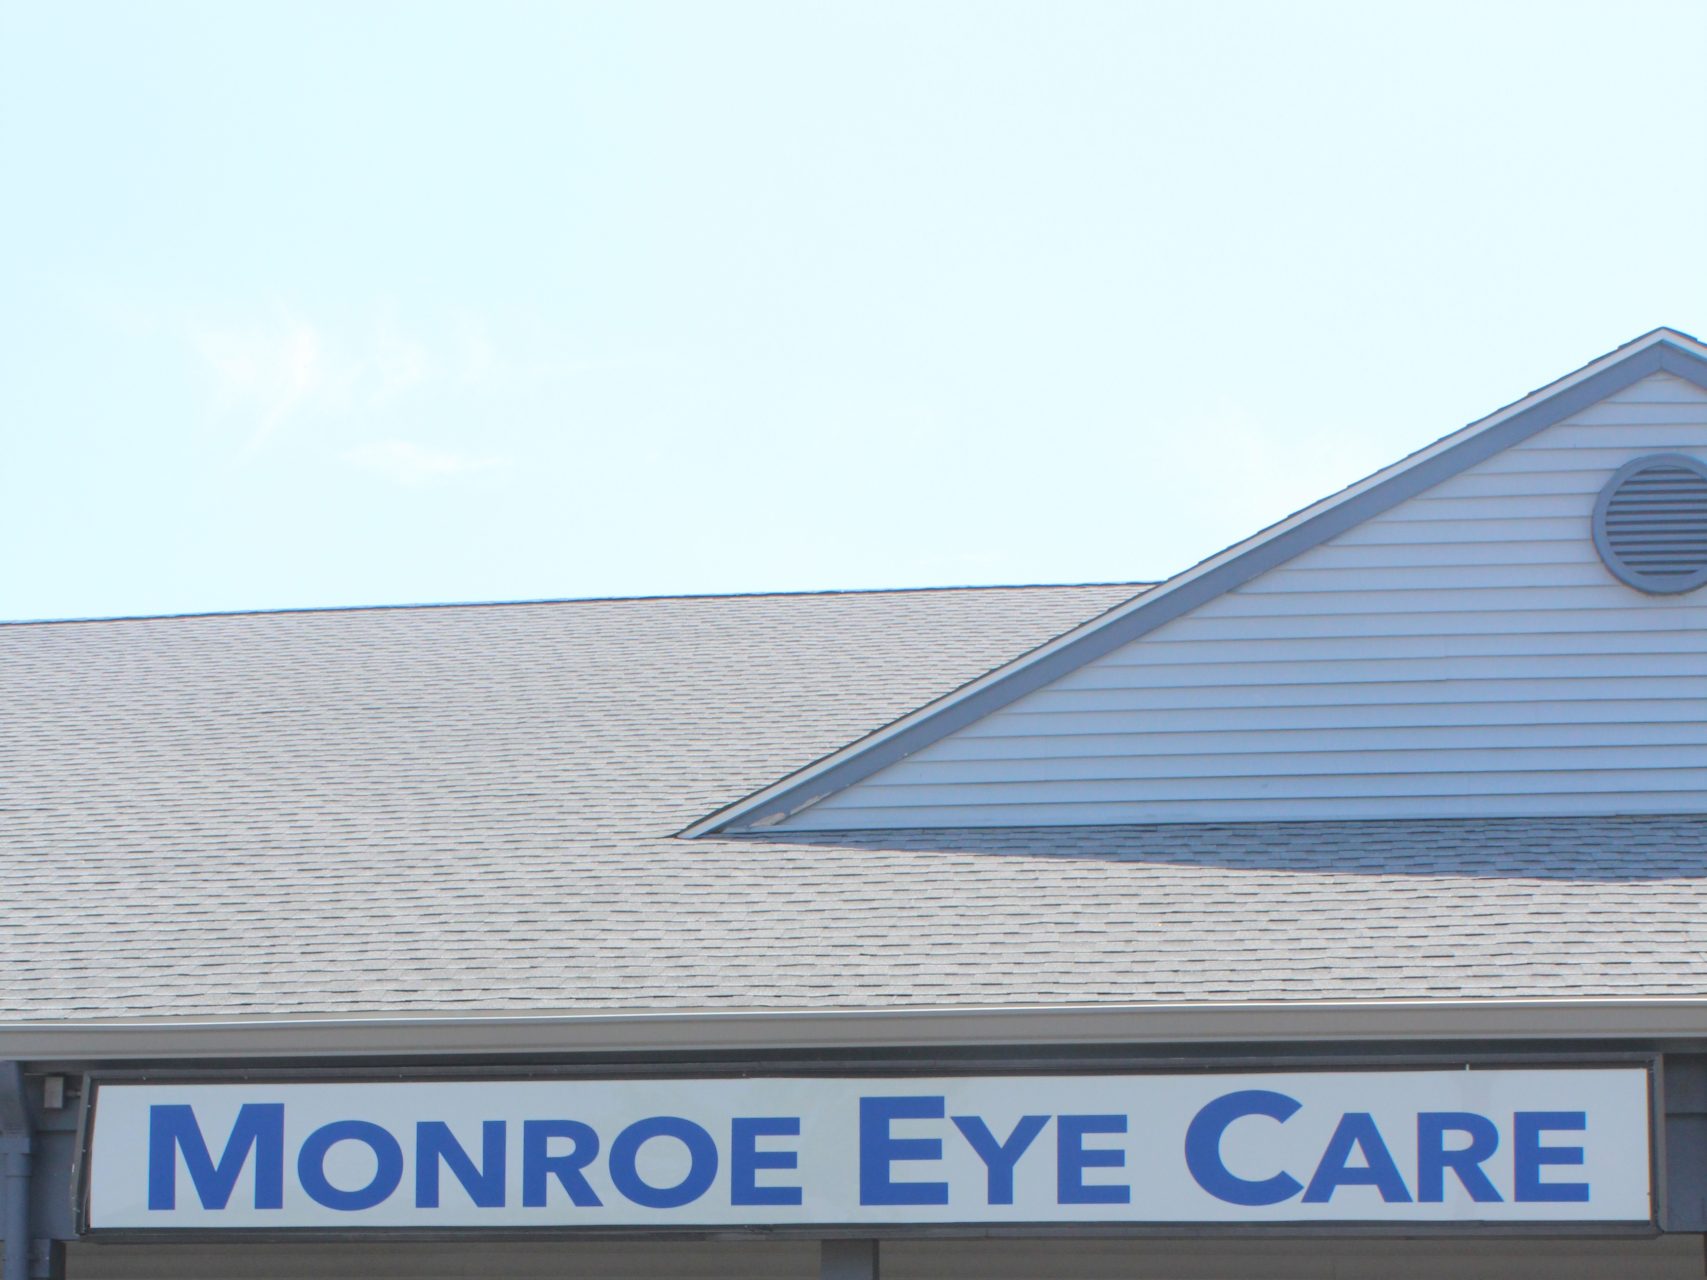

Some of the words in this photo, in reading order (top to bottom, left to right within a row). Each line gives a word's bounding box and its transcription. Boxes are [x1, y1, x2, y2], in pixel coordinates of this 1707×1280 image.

[148, 1102, 803, 1211] MONROE
[859, 1096, 1131, 1206] EYE
[1184, 1089, 1590, 1207] CARE
